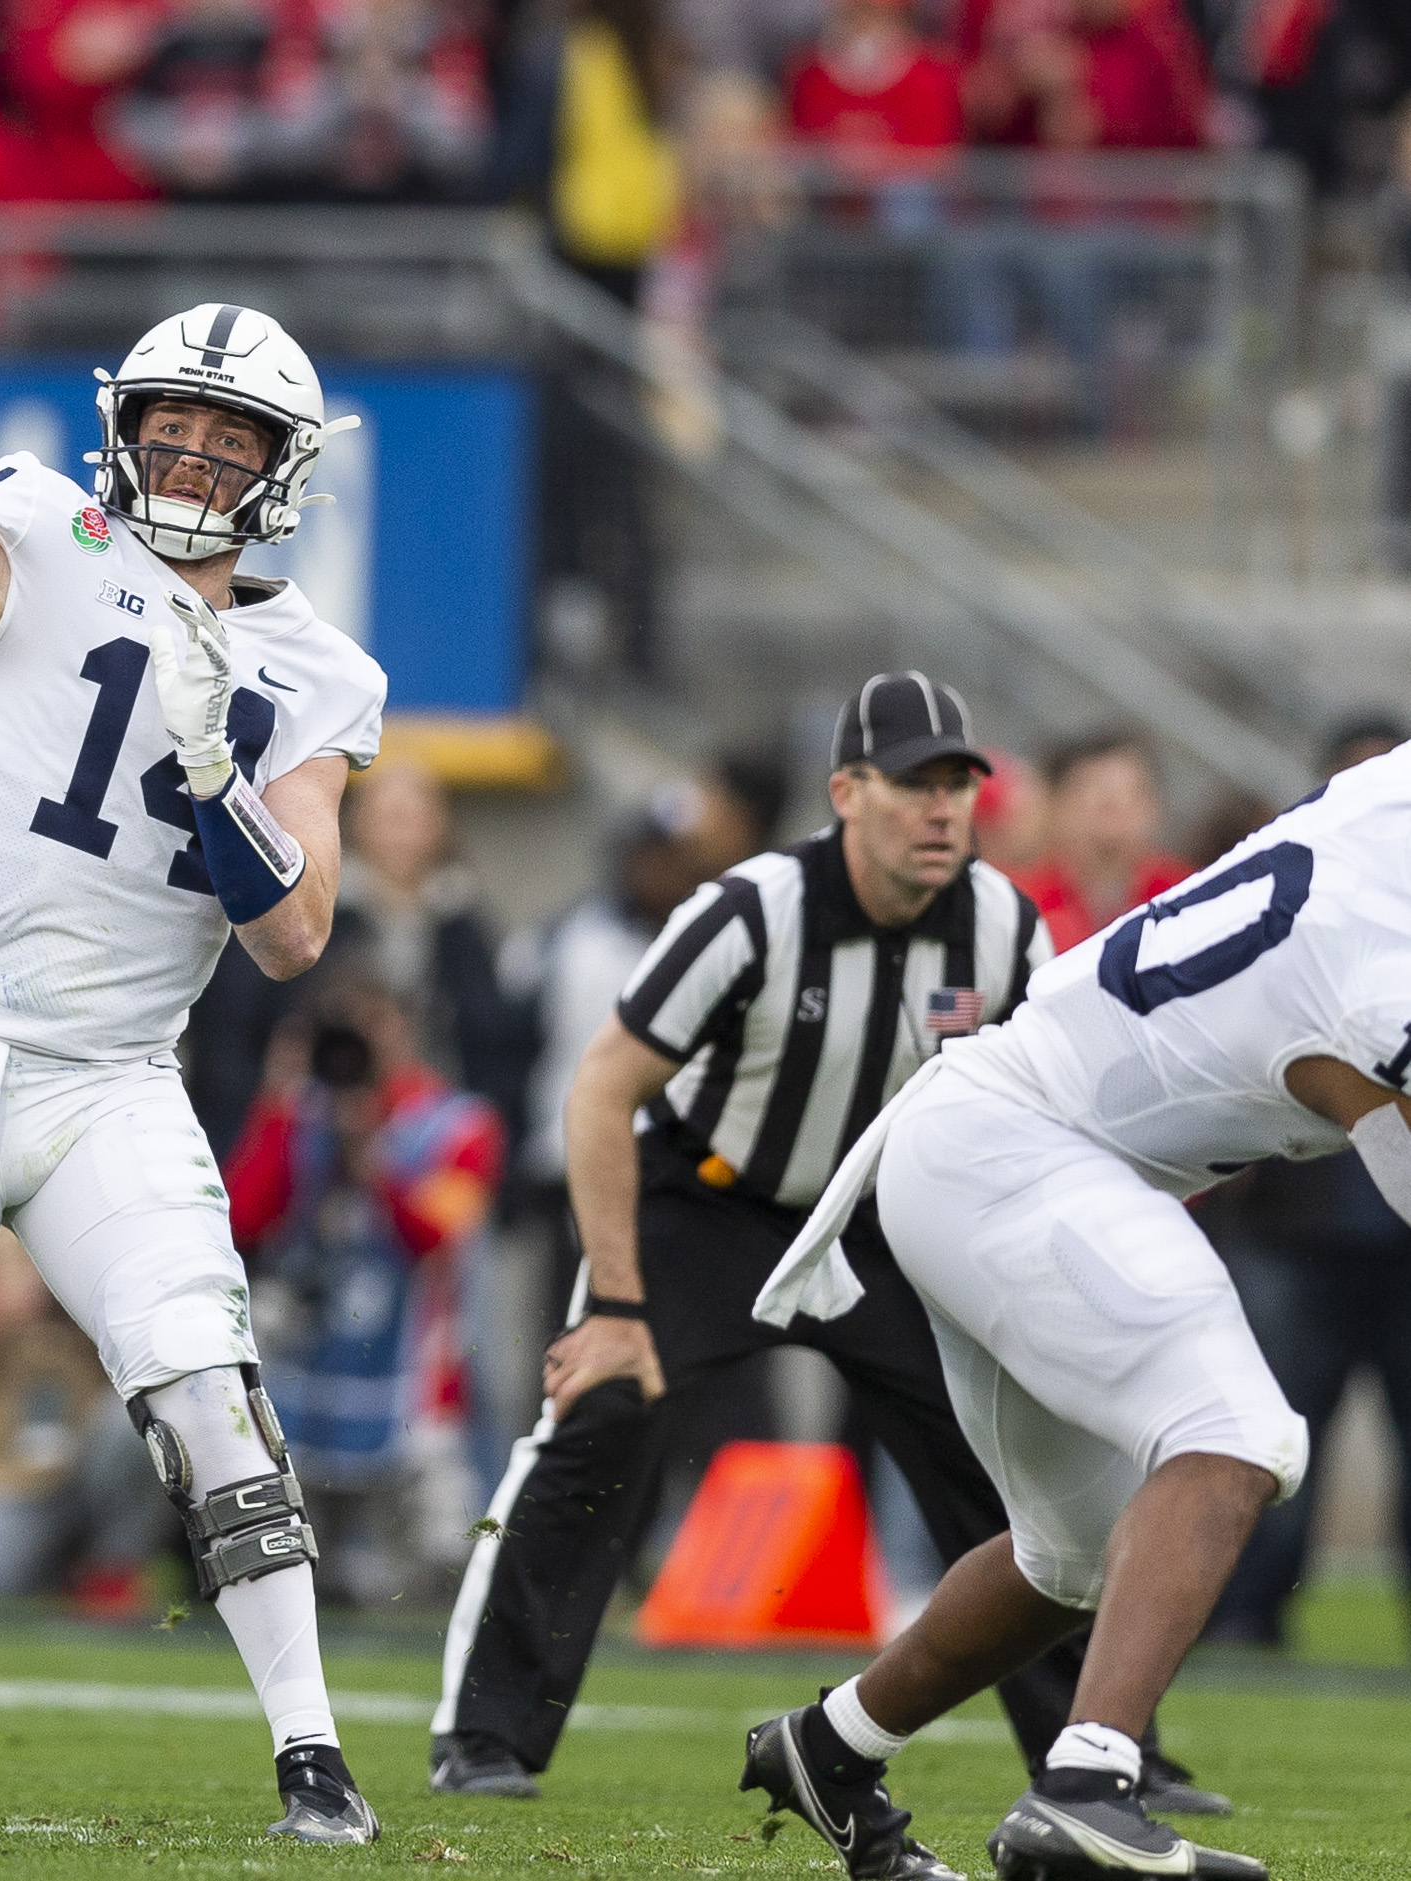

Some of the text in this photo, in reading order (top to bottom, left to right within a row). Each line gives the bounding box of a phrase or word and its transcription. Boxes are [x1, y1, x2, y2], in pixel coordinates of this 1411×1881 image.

[178, 366, 235, 384] PENN STATE
[28, 636, 276, 897] 14
[796, 986, 827, 1022] S
